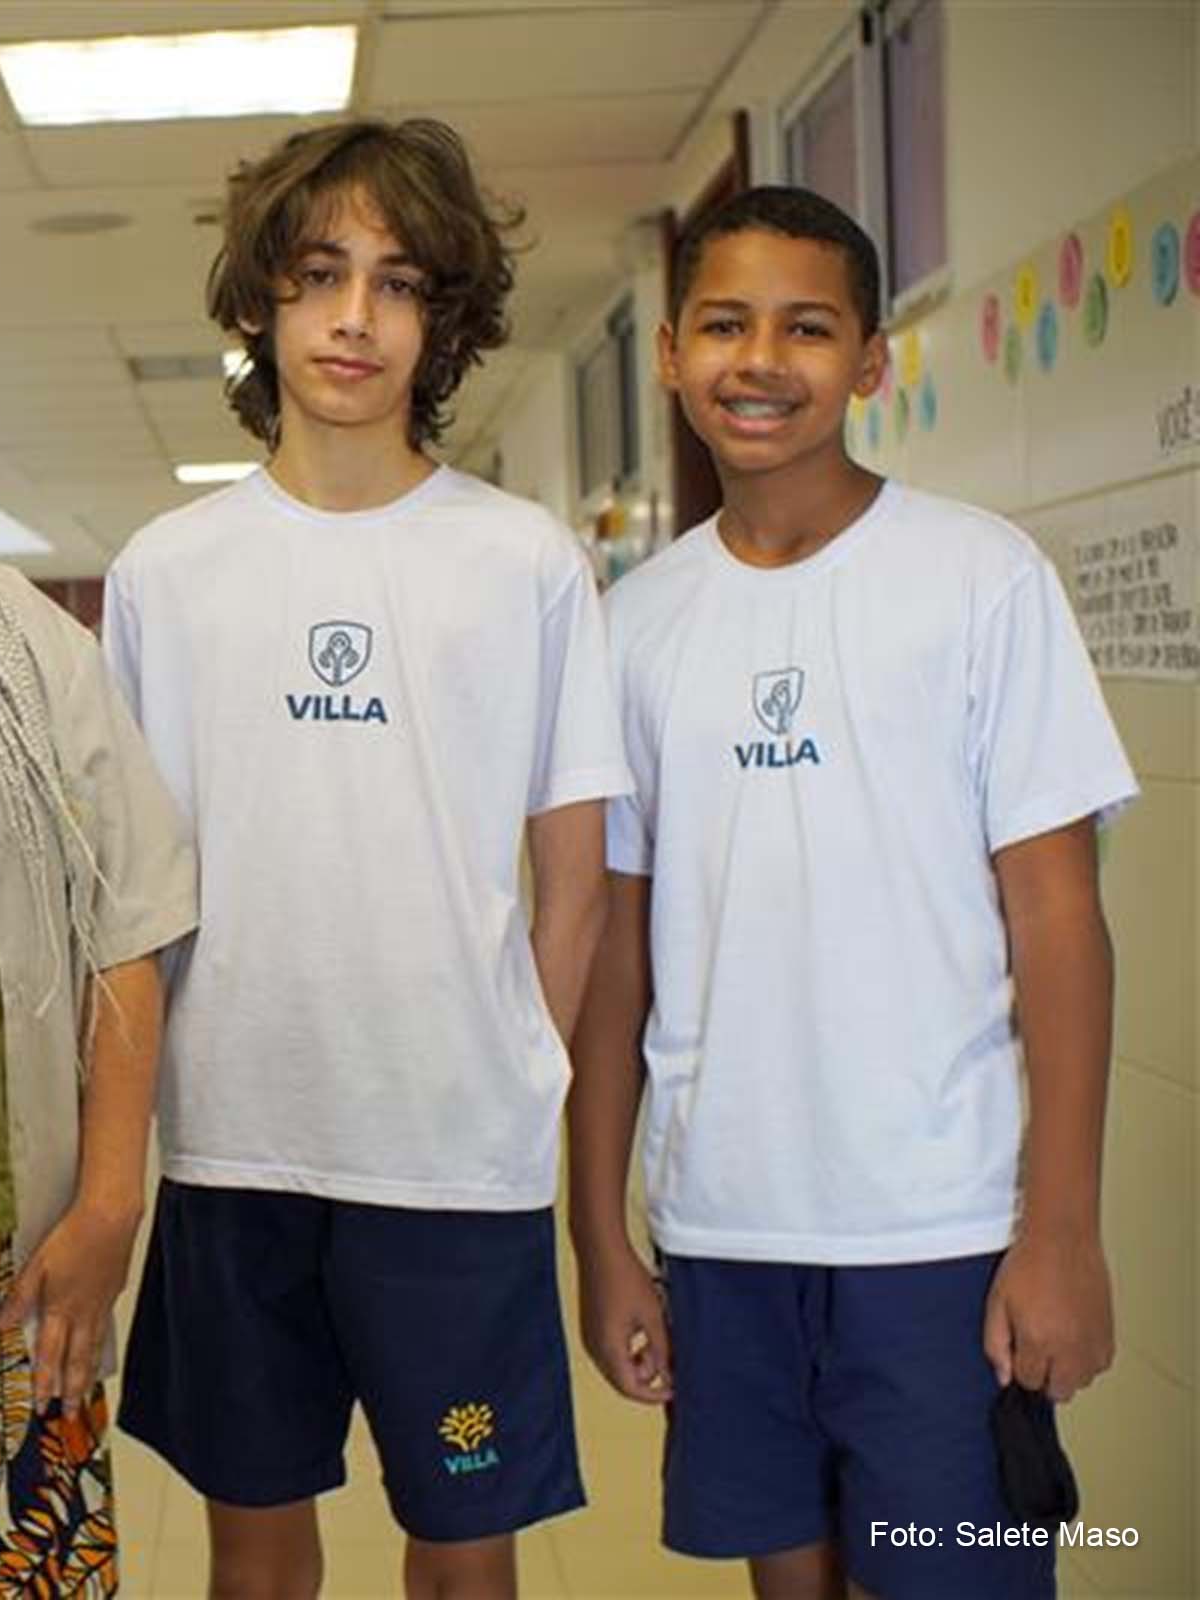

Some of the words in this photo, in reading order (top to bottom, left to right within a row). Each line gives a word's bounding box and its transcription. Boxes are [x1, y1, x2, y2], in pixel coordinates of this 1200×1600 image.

[286, 694, 388, 725] VILLA
[734, 738, 820, 768] VILLA
[443, 1447, 499, 1475] VILLA
